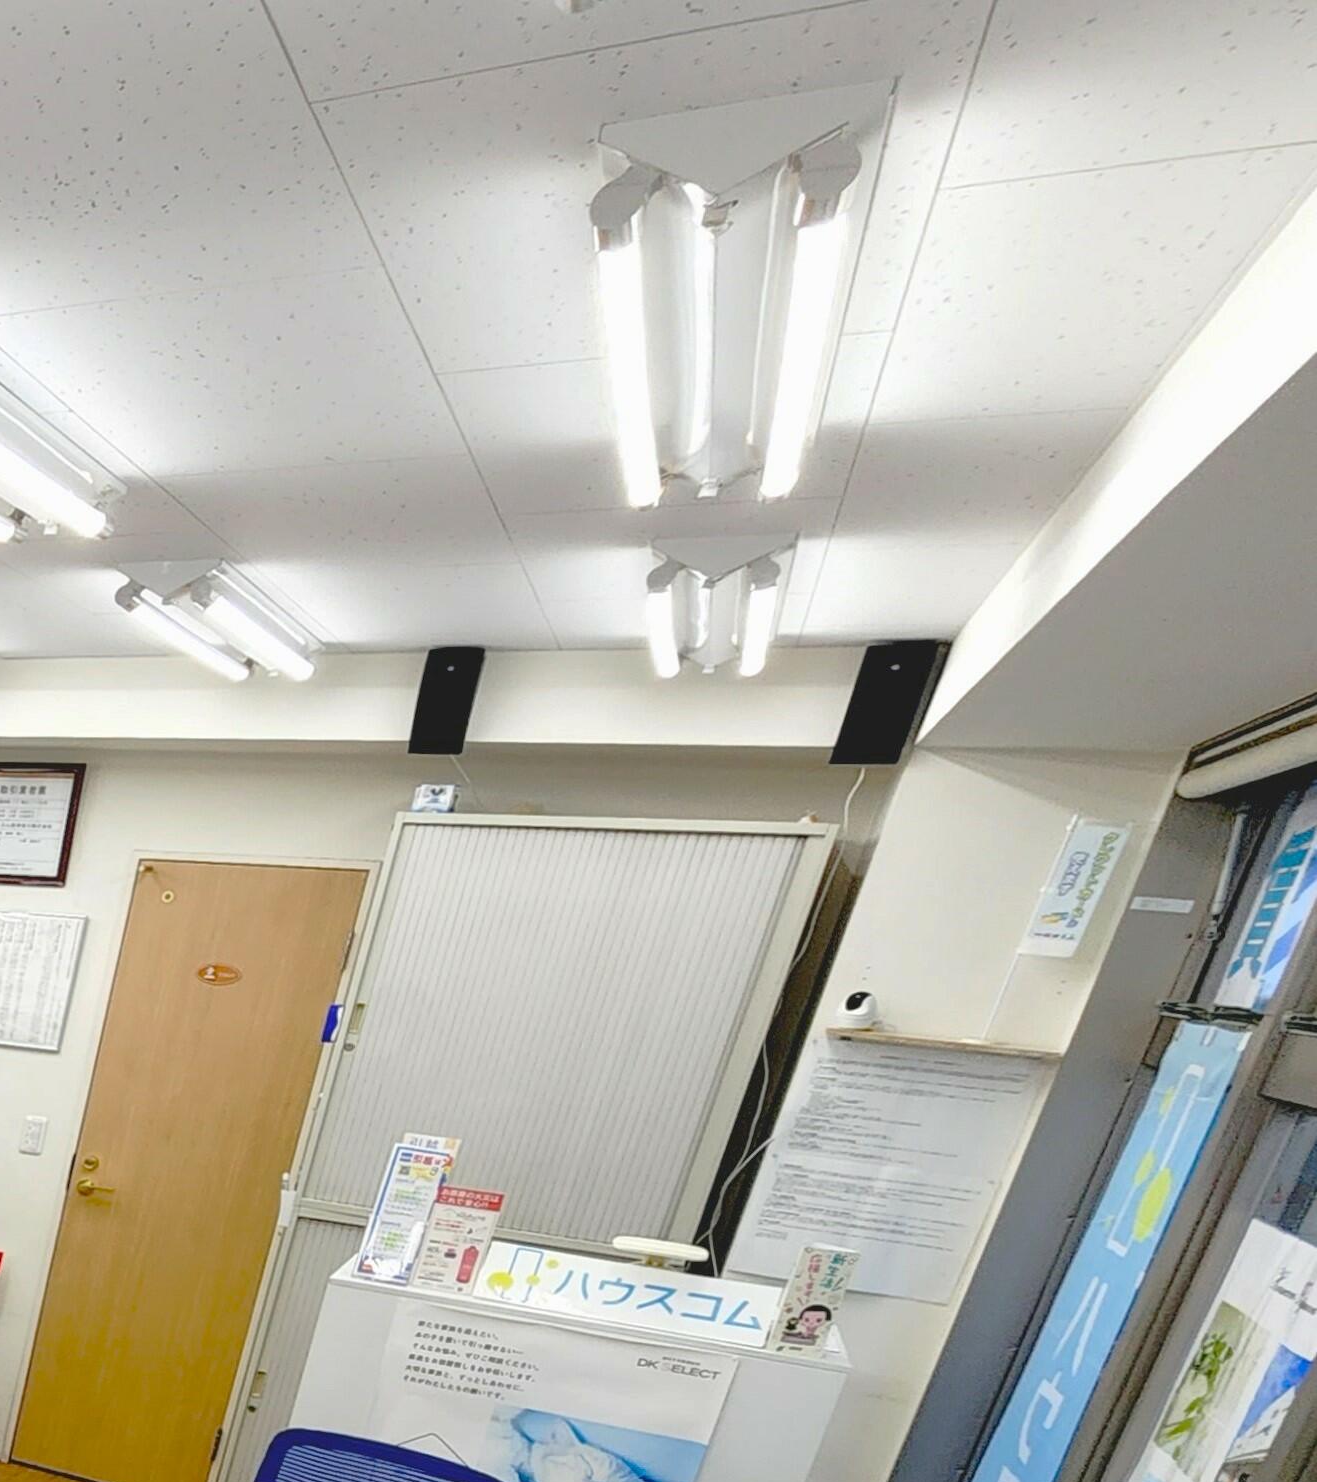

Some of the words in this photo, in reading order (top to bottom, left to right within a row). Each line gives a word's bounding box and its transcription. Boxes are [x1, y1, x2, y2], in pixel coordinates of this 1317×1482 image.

[553, 1268, 763, 1332] ハウスコム
[636, 1357, 660, 1370] DK
